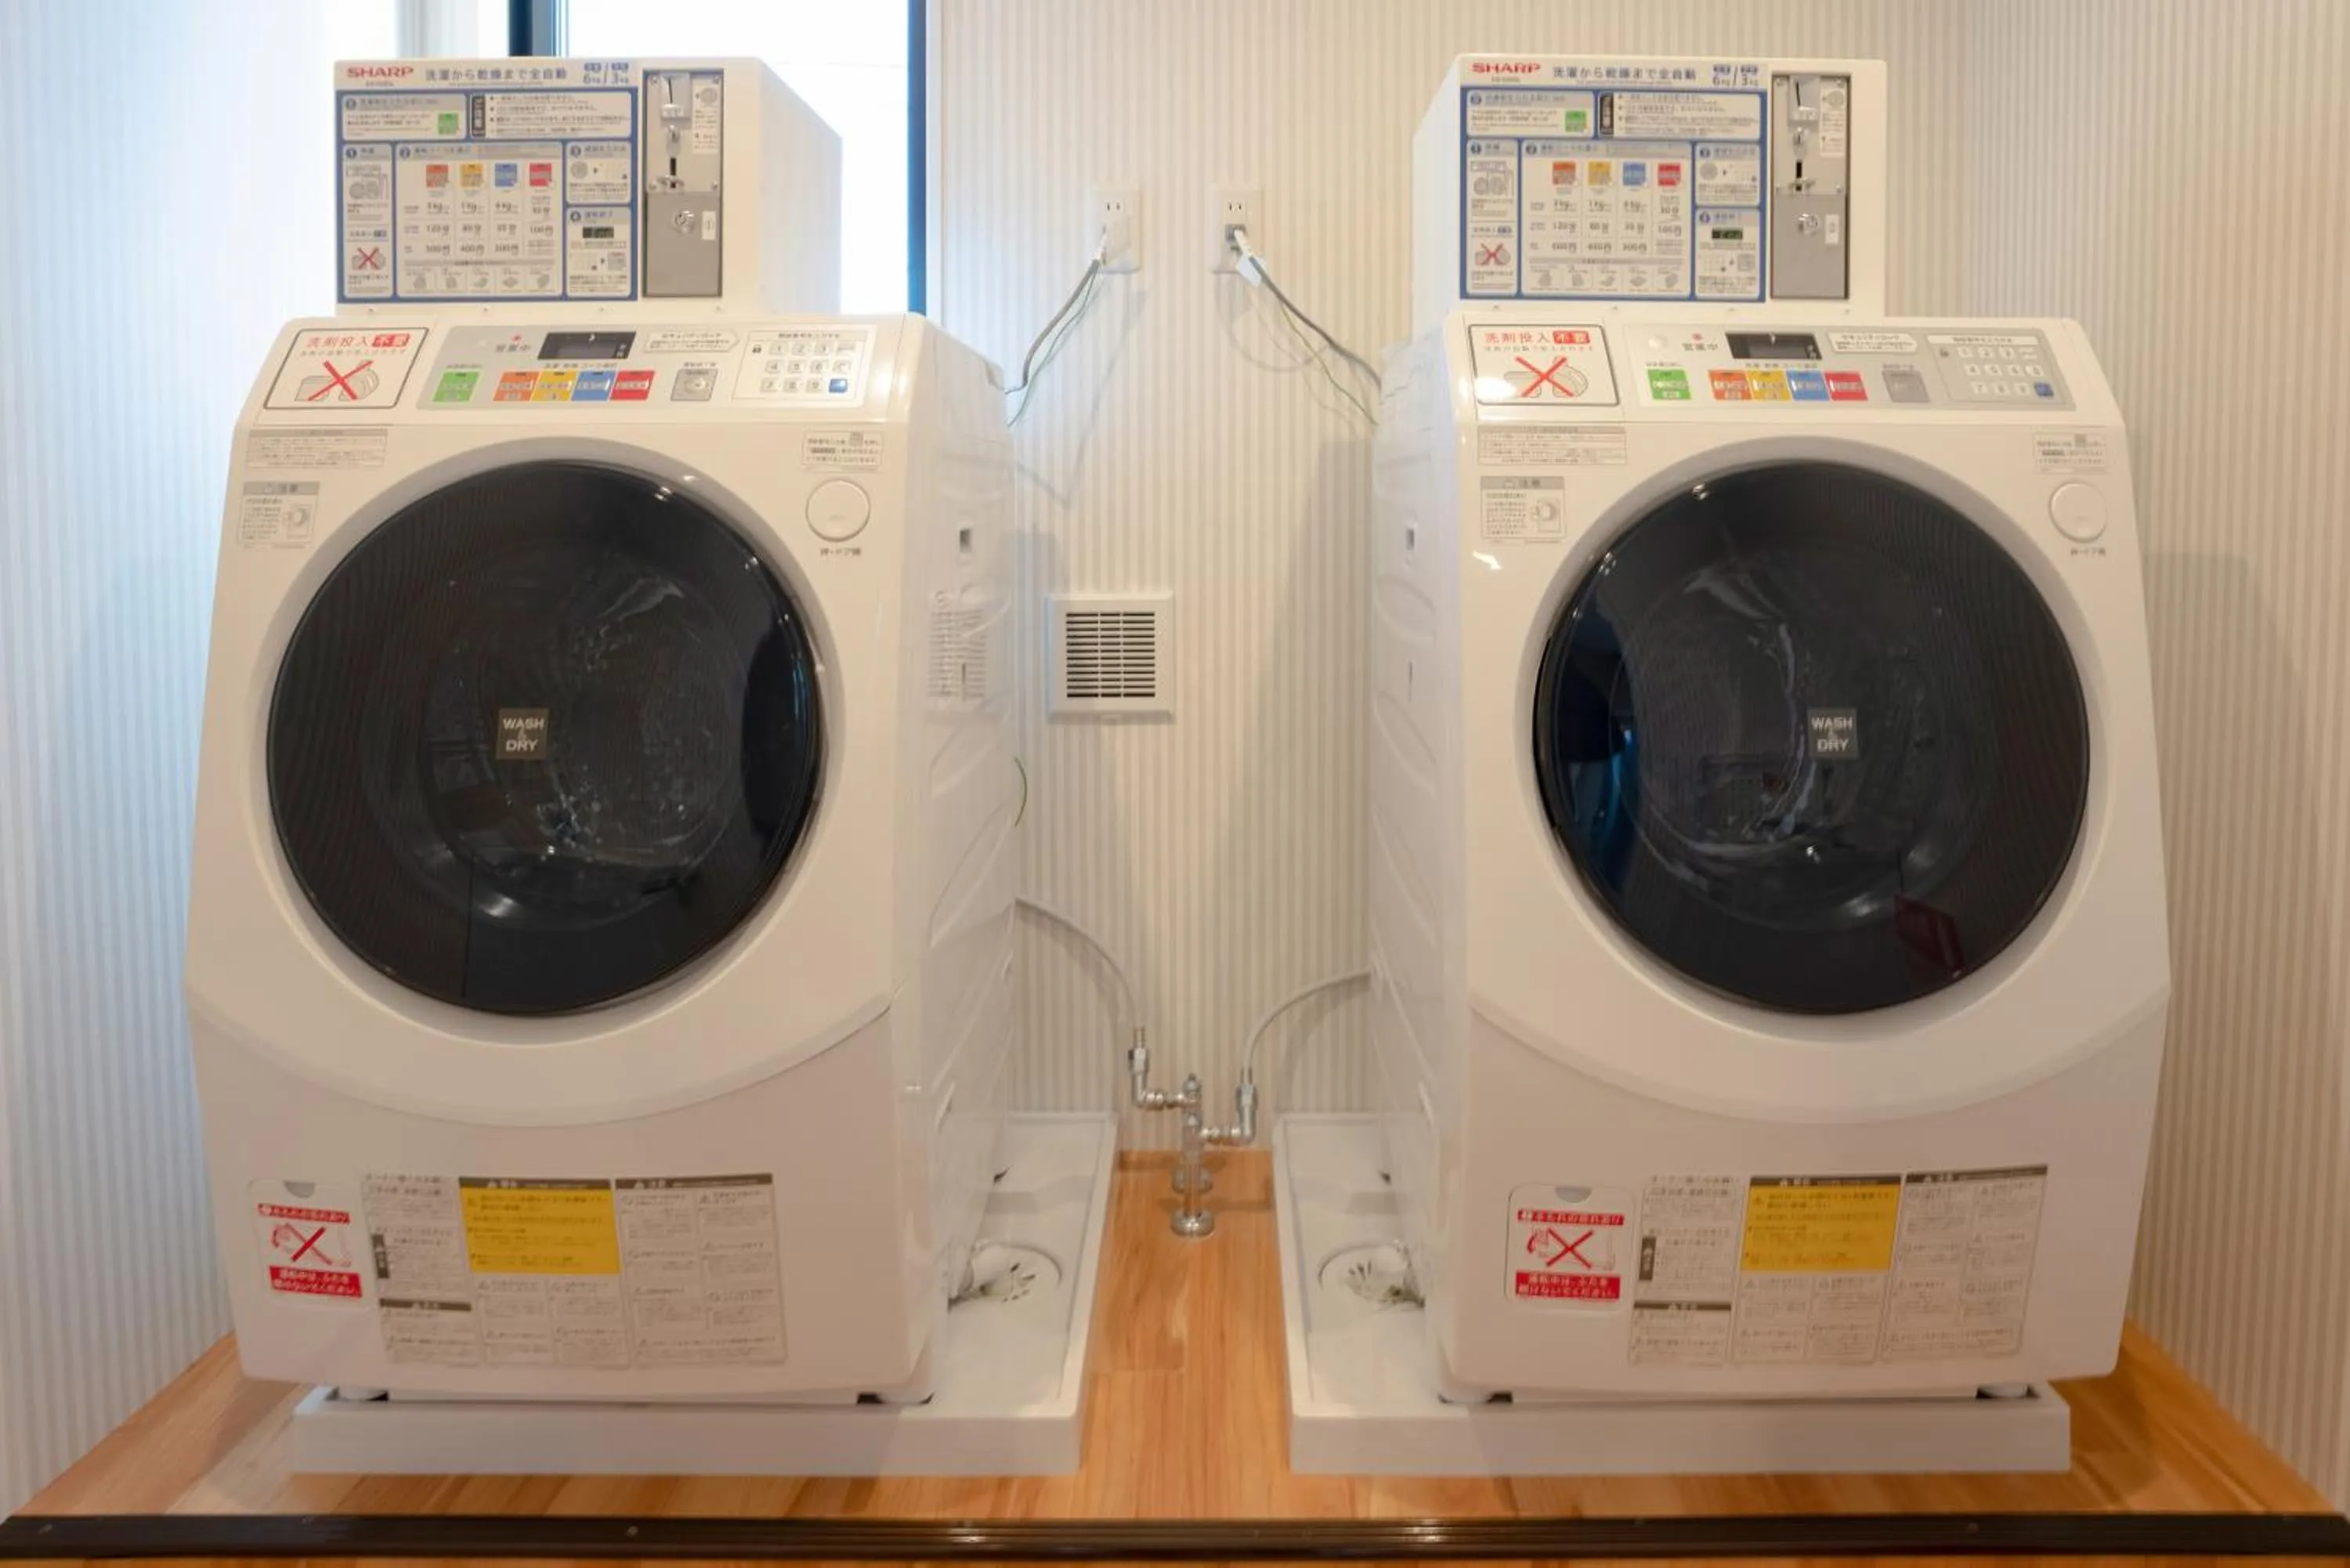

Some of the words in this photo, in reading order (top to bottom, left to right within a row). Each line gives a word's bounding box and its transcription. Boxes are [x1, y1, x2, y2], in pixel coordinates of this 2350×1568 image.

[347, 66, 414, 78] SHARP
[1472, 63, 1541, 73] SHARP
[503, 717, 544, 730] WASH
[1811, 717, 1853, 730] WASH
[505, 739, 538, 752] DRY
[1817, 739, 1849, 752] DRY
